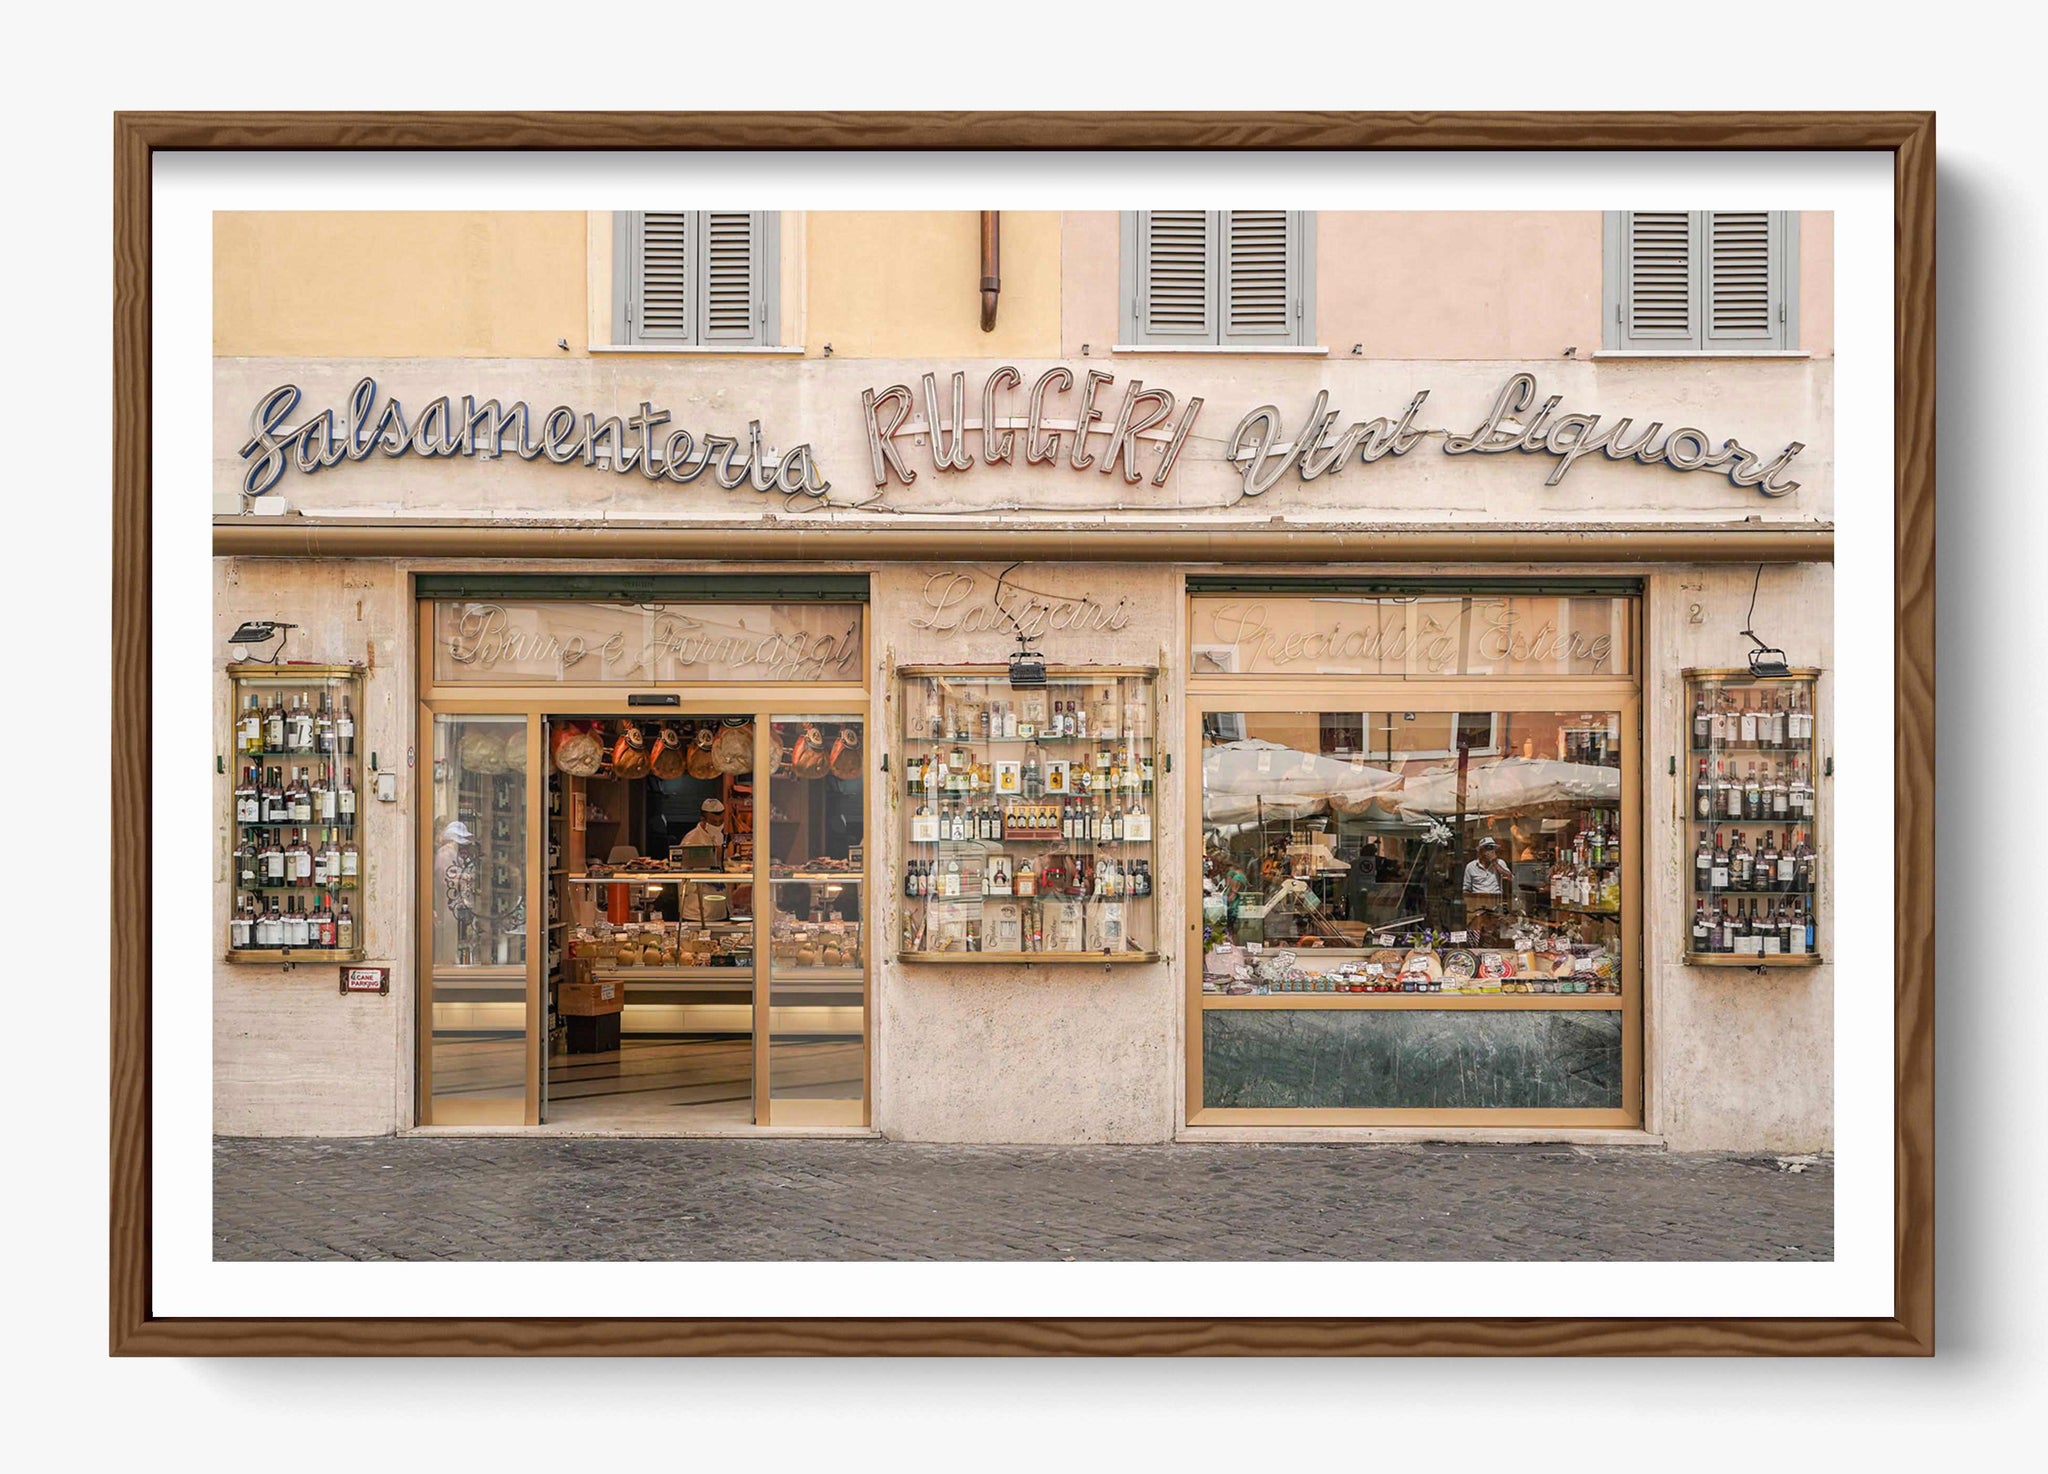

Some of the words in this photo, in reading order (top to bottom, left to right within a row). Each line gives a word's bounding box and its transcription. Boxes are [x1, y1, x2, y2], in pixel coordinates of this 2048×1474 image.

[237, 376, 831, 497] Salsamenteria
[862, 366, 1205, 487] RUGGERI
[1227, 389, 1431, 496] Vini
[1442, 373, 1806, 498] Liquori
[450, 603, 586, 668] Burro
[635, 611, 856, 681] Formaggi
[1689, 603, 1704, 625] 2
[350, 980, 379, 988] PARKING
